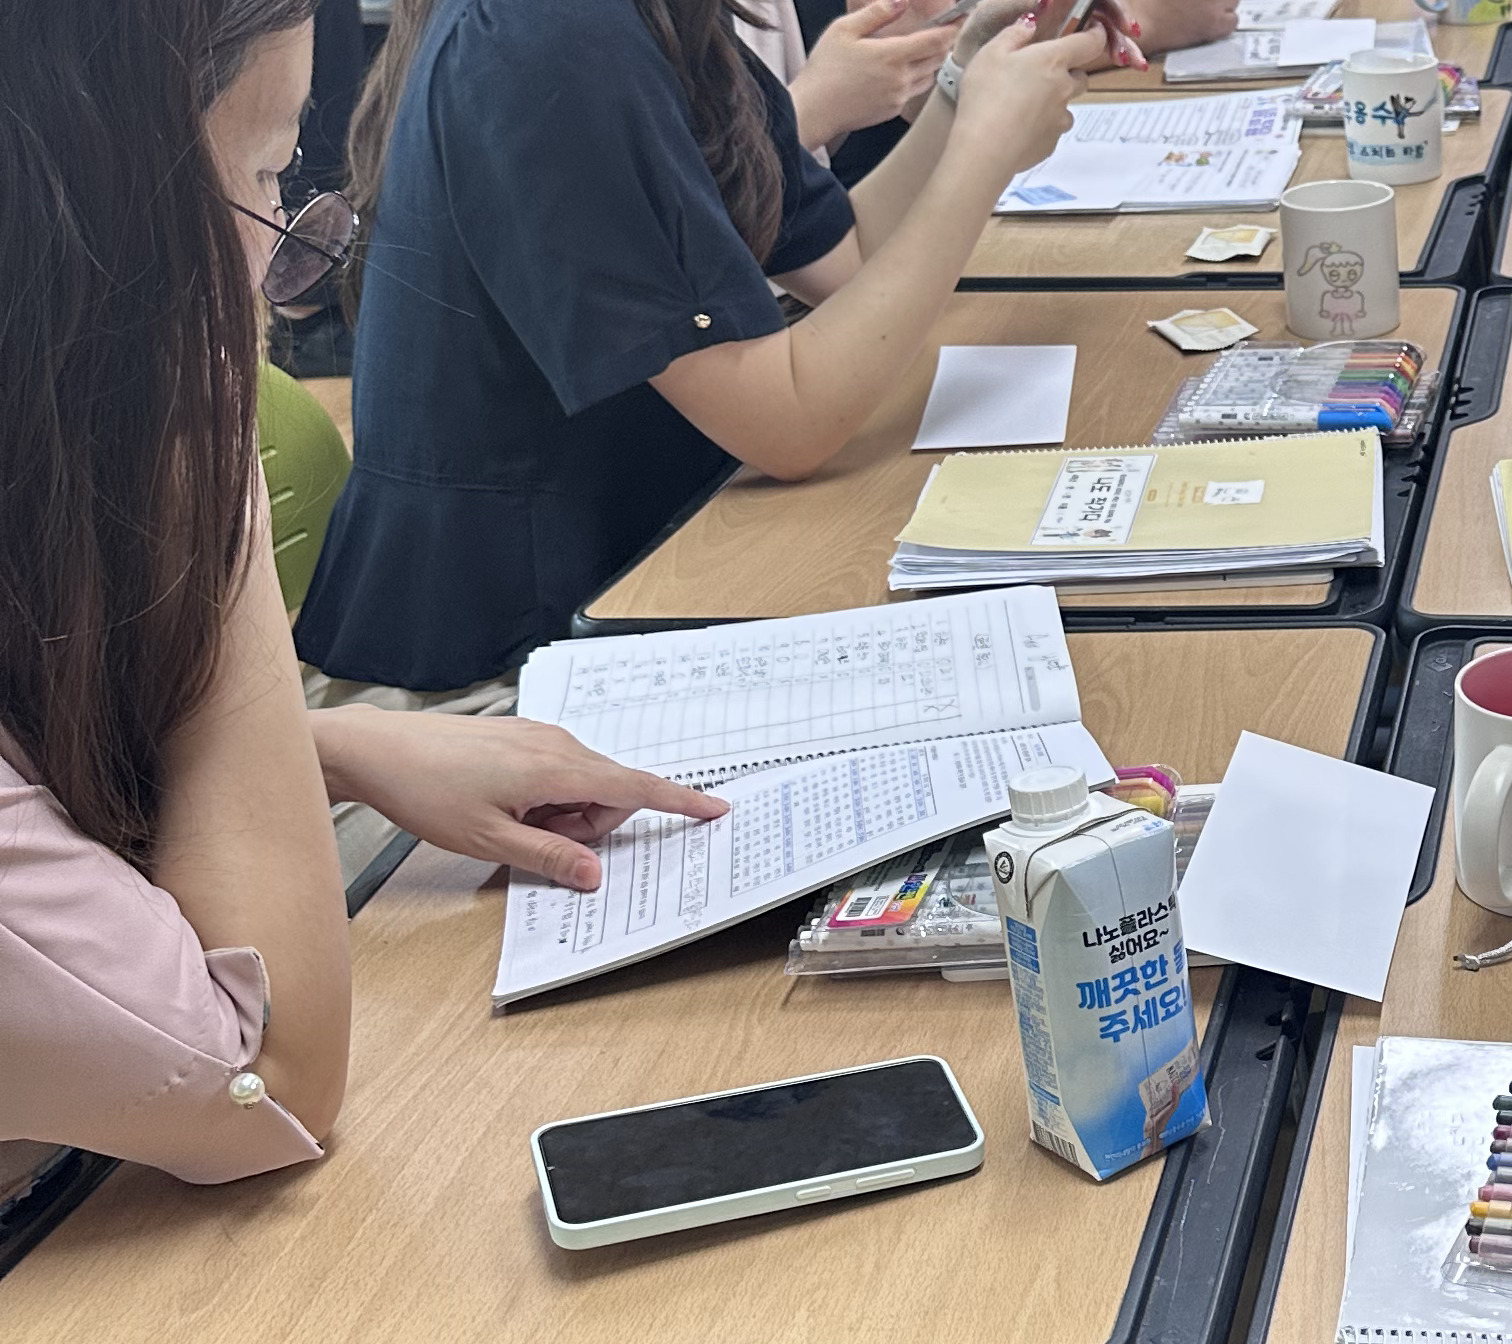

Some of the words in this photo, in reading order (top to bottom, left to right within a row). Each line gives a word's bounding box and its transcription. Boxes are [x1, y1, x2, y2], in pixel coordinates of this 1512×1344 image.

[1108, 928, 1170, 964] 싫어요~
[1076, 953, 1169, 1010] 깨끗한
[1099, 980, 1187, 1043] 주세요!
